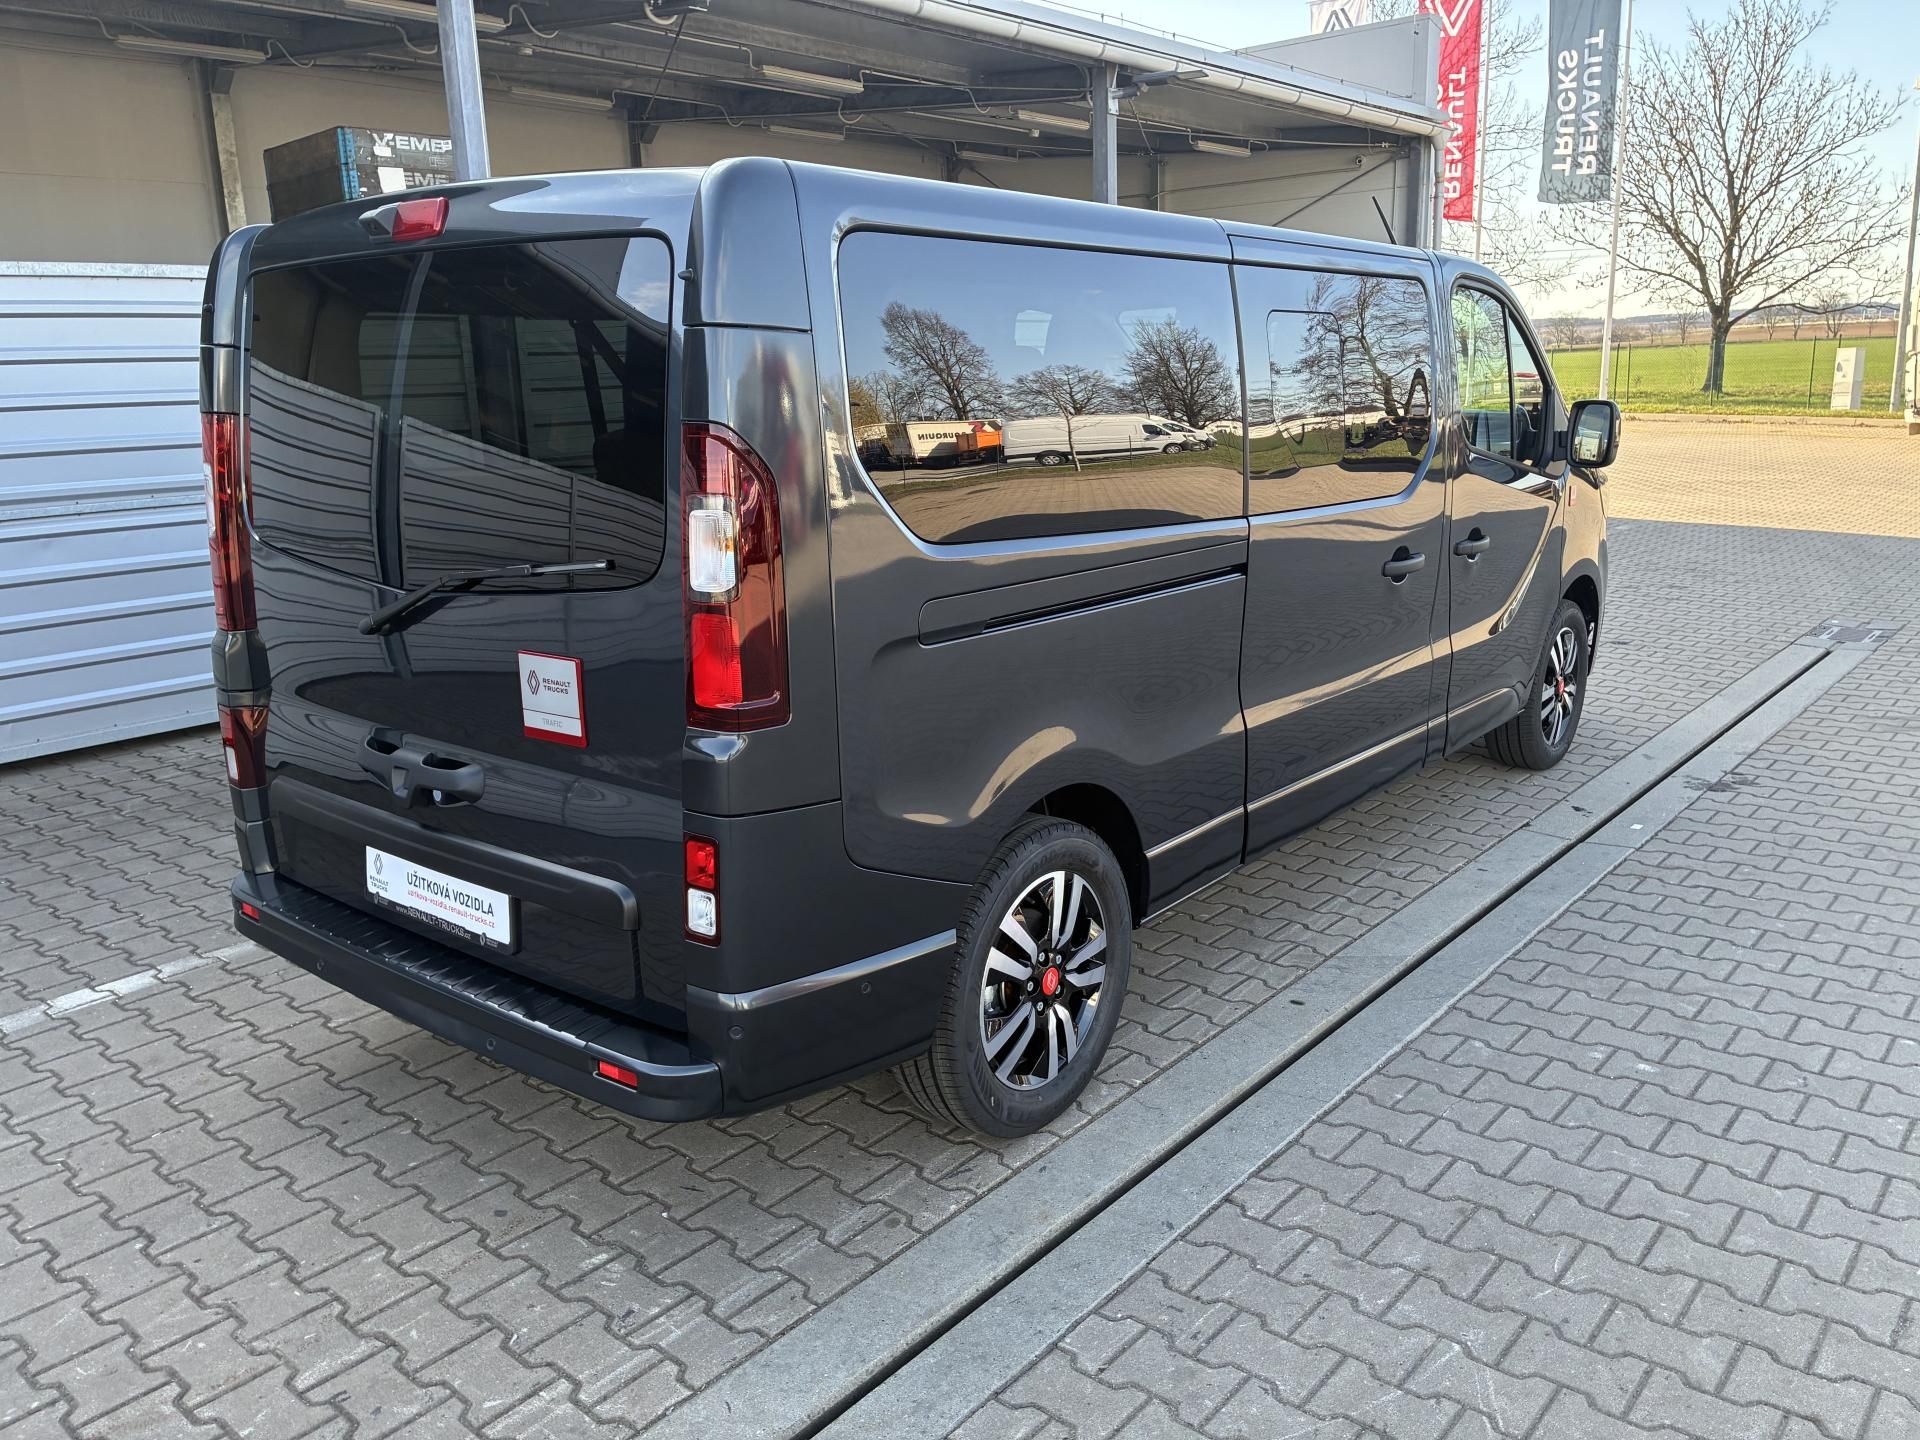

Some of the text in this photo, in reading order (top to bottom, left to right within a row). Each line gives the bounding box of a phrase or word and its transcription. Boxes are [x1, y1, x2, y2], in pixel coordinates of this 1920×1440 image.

[542, 678, 571, 688] RENAULT
[543, 685, 569, 695] TRUCKS
[406, 870, 494, 917] UŽITKOVÁ VOZIDLA
